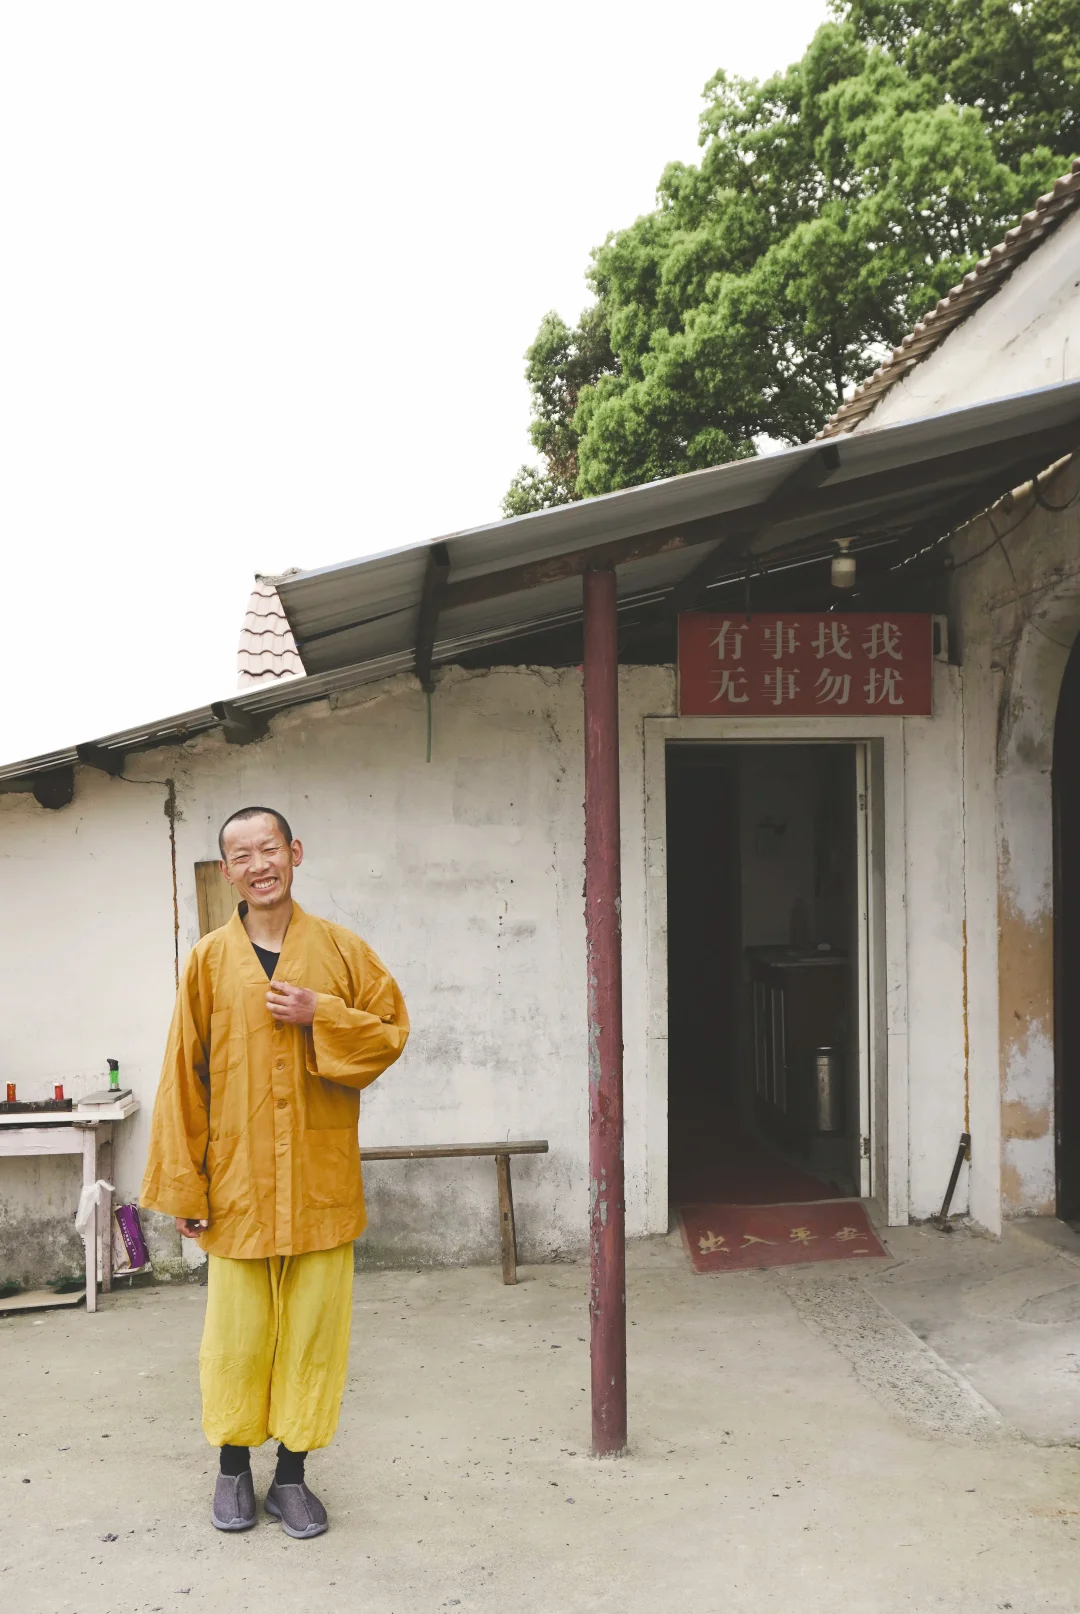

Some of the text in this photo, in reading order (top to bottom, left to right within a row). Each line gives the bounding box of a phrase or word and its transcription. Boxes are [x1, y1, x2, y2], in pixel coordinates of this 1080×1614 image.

[708, 620, 903, 660] 有事找我
[708, 666, 904, 705] 无事勿扰
[697, 1225, 869, 1255] 出入平安
